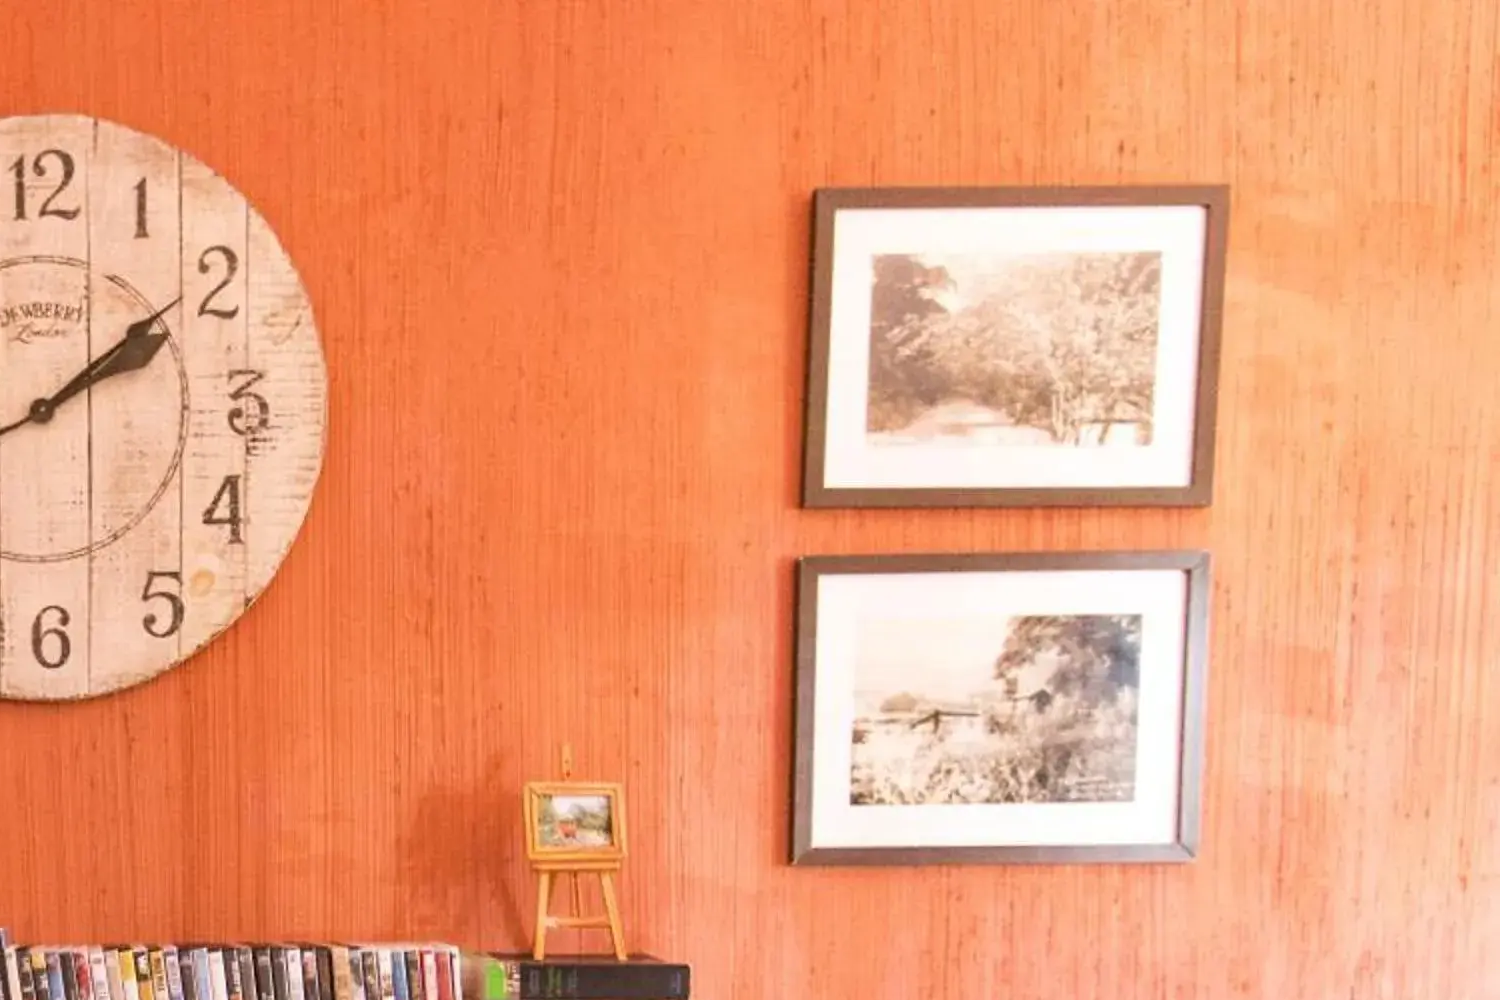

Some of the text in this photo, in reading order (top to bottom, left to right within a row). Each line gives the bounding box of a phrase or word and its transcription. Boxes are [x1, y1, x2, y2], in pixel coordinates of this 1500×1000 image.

[8, 149, 81, 222] 12
[132, 178, 150, 239] 1
[197, 246, 240, 319] 2
[227, 370, 270, 438] 3
[201, 474, 244, 544] 4
[31, 606, 71, 669] 6
[142, 572, 185, 638] 5
